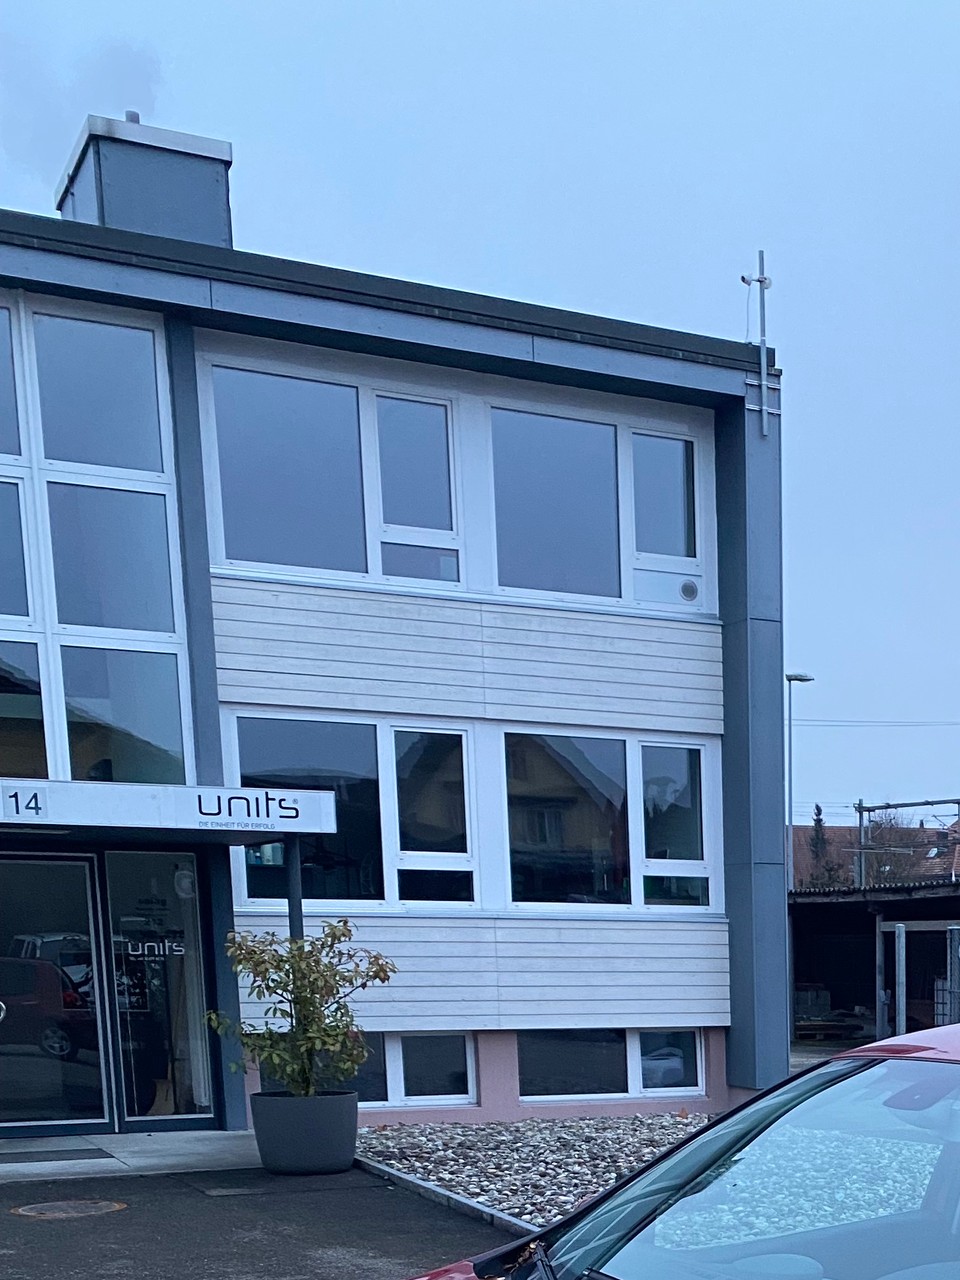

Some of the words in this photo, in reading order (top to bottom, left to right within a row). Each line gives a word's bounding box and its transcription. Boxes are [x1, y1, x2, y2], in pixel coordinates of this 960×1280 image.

[9, 791, 42, 815] 14
[197, 791, 299, 819] units
[210, 821, 235, 829] EINHEIT
[237, 821, 249, 829] FÜR
[251, 822, 275, 830] ERFOLG
[127, 939, 186, 956] units
